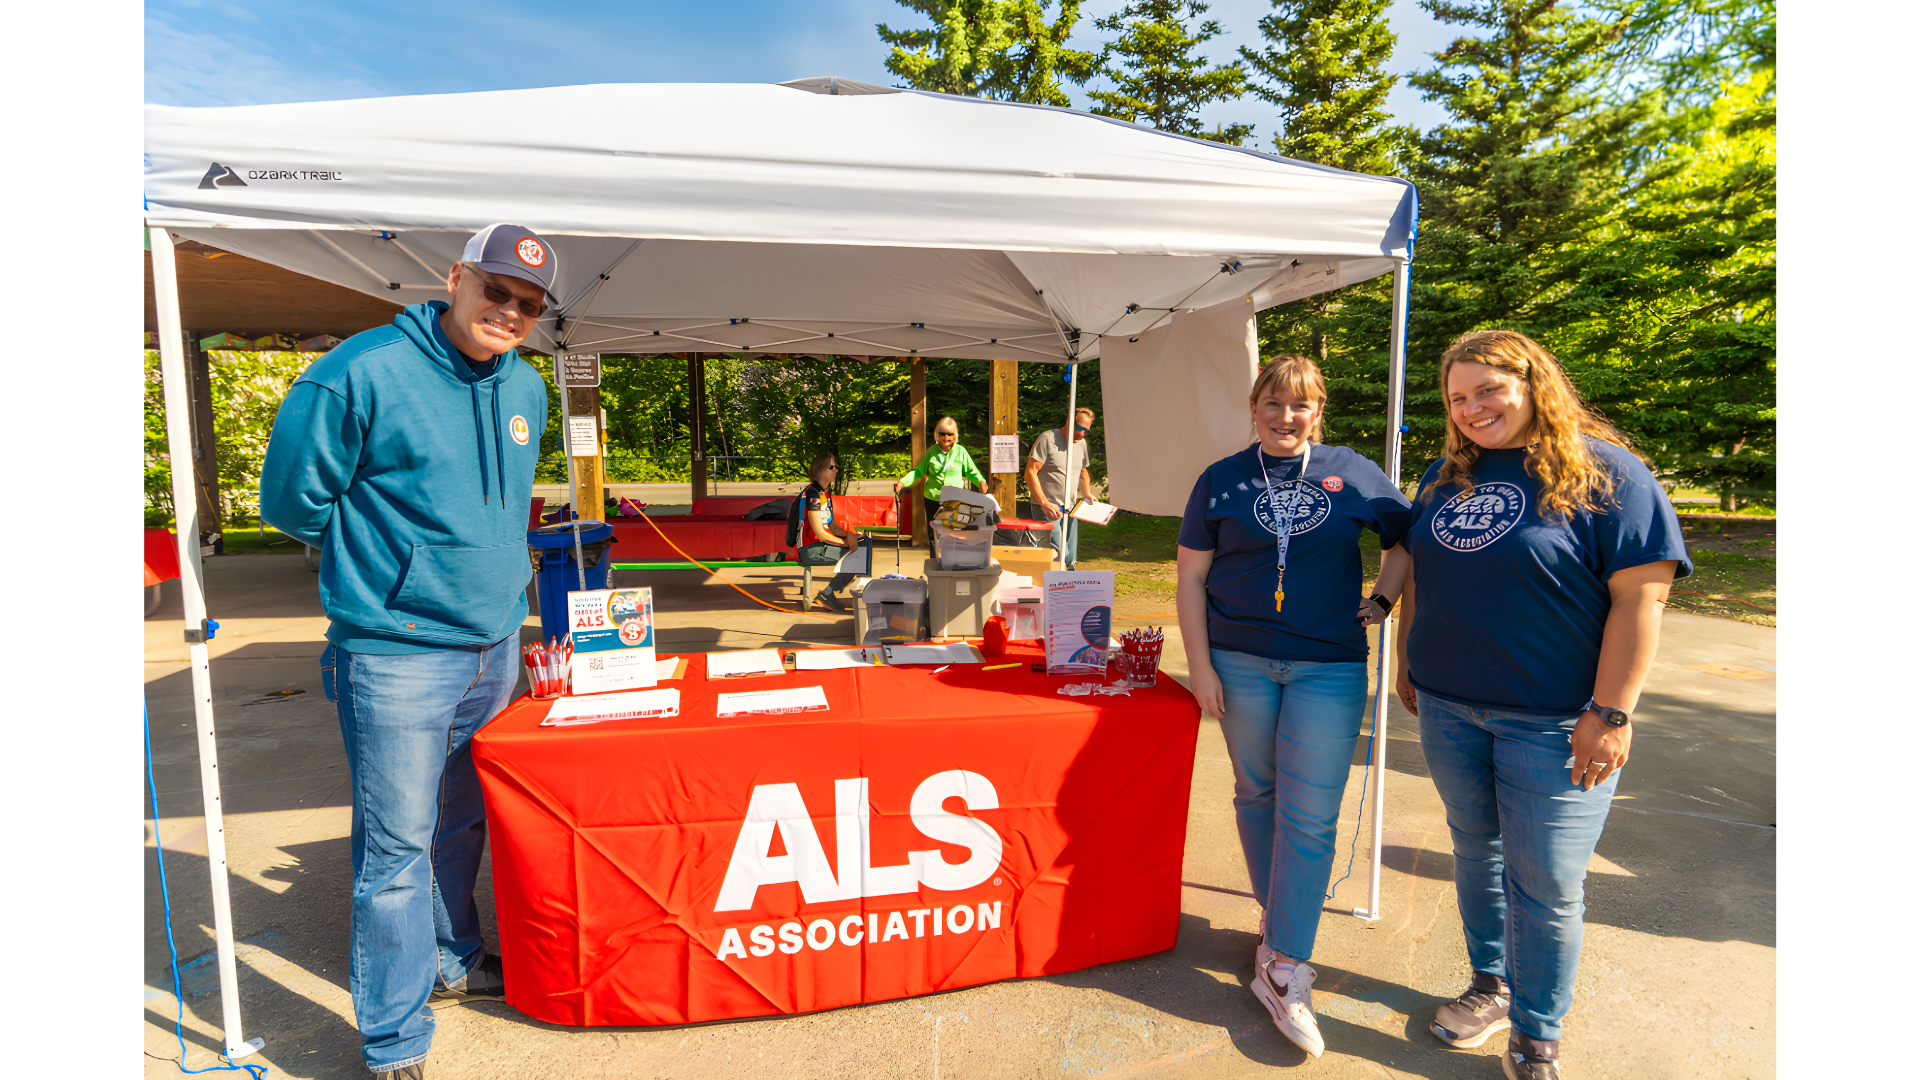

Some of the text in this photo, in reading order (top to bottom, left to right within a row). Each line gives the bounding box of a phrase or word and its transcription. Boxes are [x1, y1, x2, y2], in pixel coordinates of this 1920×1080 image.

[1448, 514, 1494, 530] ALS
[576, 615, 605, 628] ALS
[713, 769, 1003, 912] ALS
[716, 901, 1001, 961] ASSOCIATION
